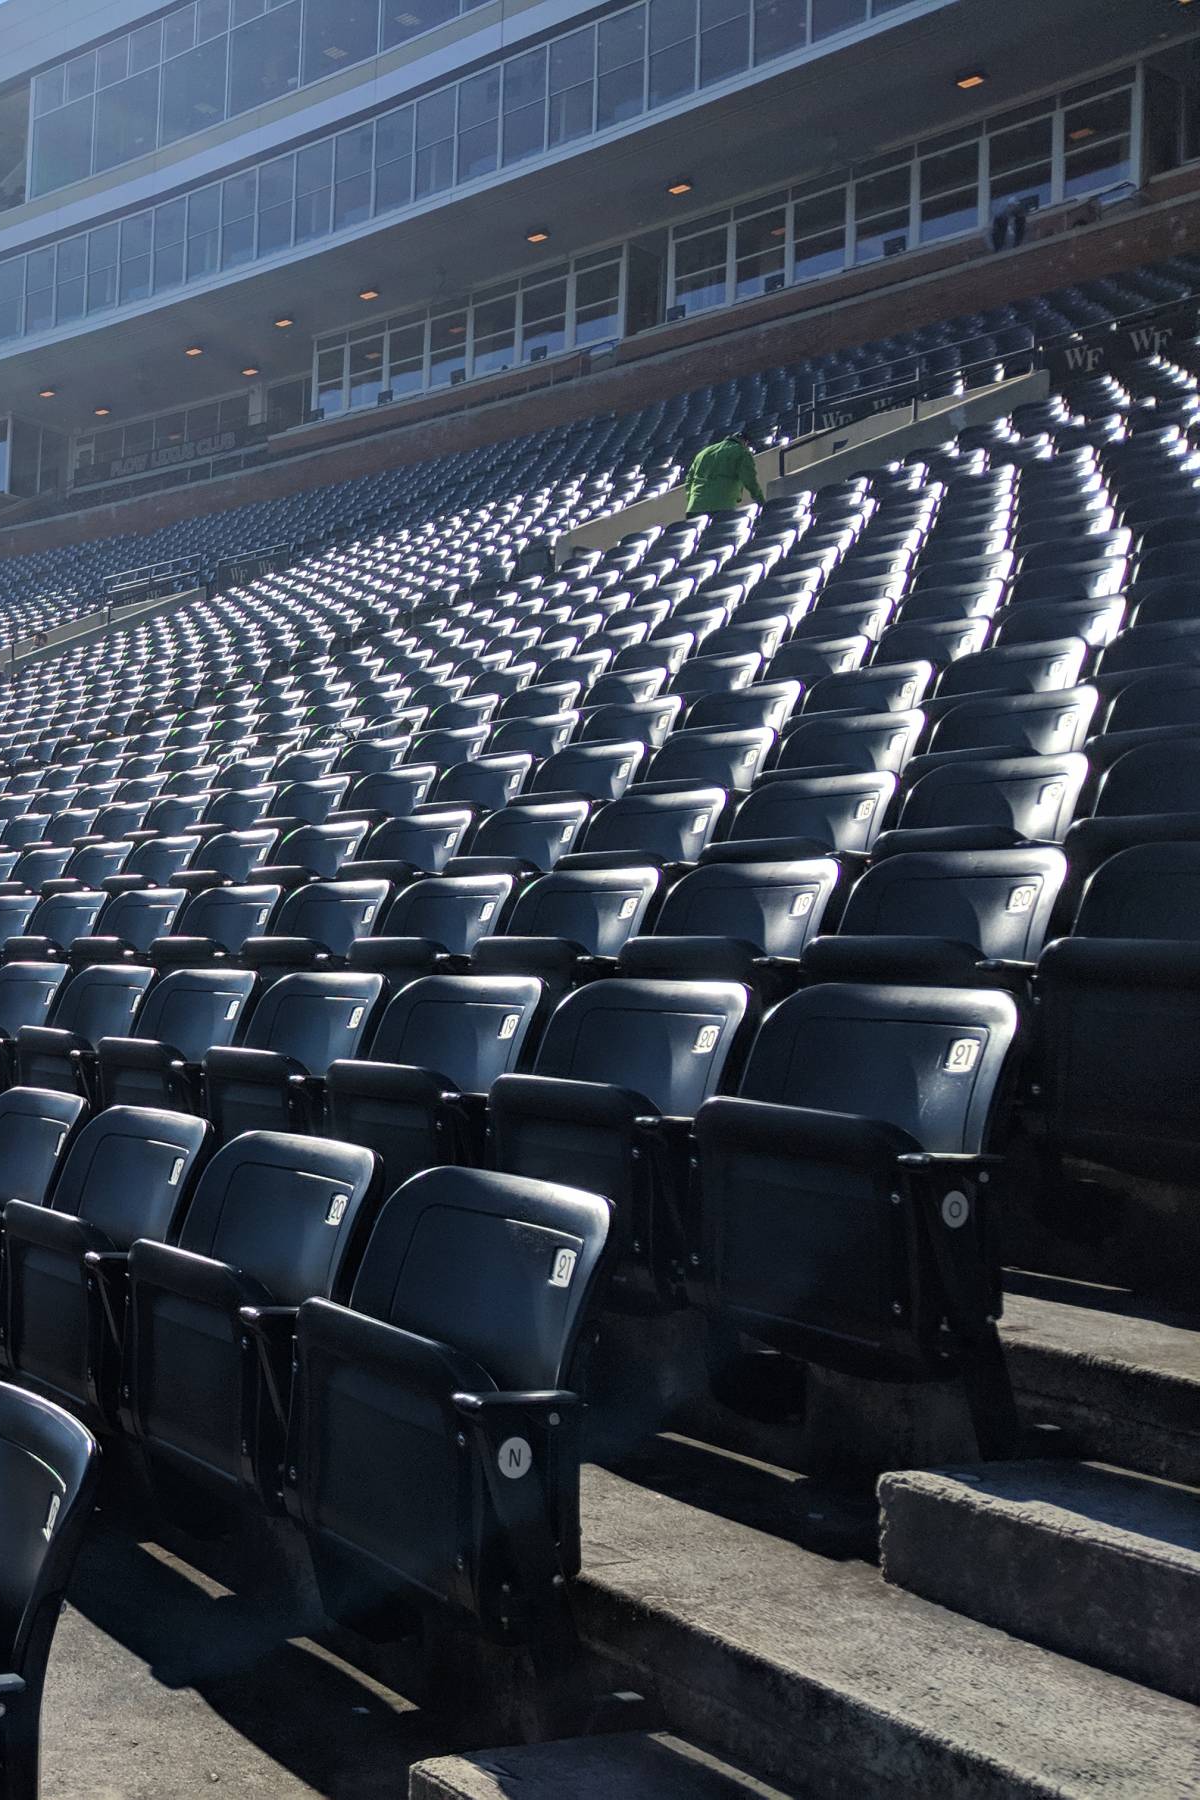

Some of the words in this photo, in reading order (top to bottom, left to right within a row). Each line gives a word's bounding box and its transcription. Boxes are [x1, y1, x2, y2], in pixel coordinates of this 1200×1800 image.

[1064, 344, 1104, 372] WF
[797, 896, 811, 911] 19
[1012, 889, 1033, 908] 20
[503, 1017, 517, 1036] 19
[700, 1028, 717, 1049] 20
[952, 1043, 973, 1067] 21
[331, 1198, 345, 1220] 20
[556, 1254, 572, 1280] 21
[508, 1447, 523, 1469] N
